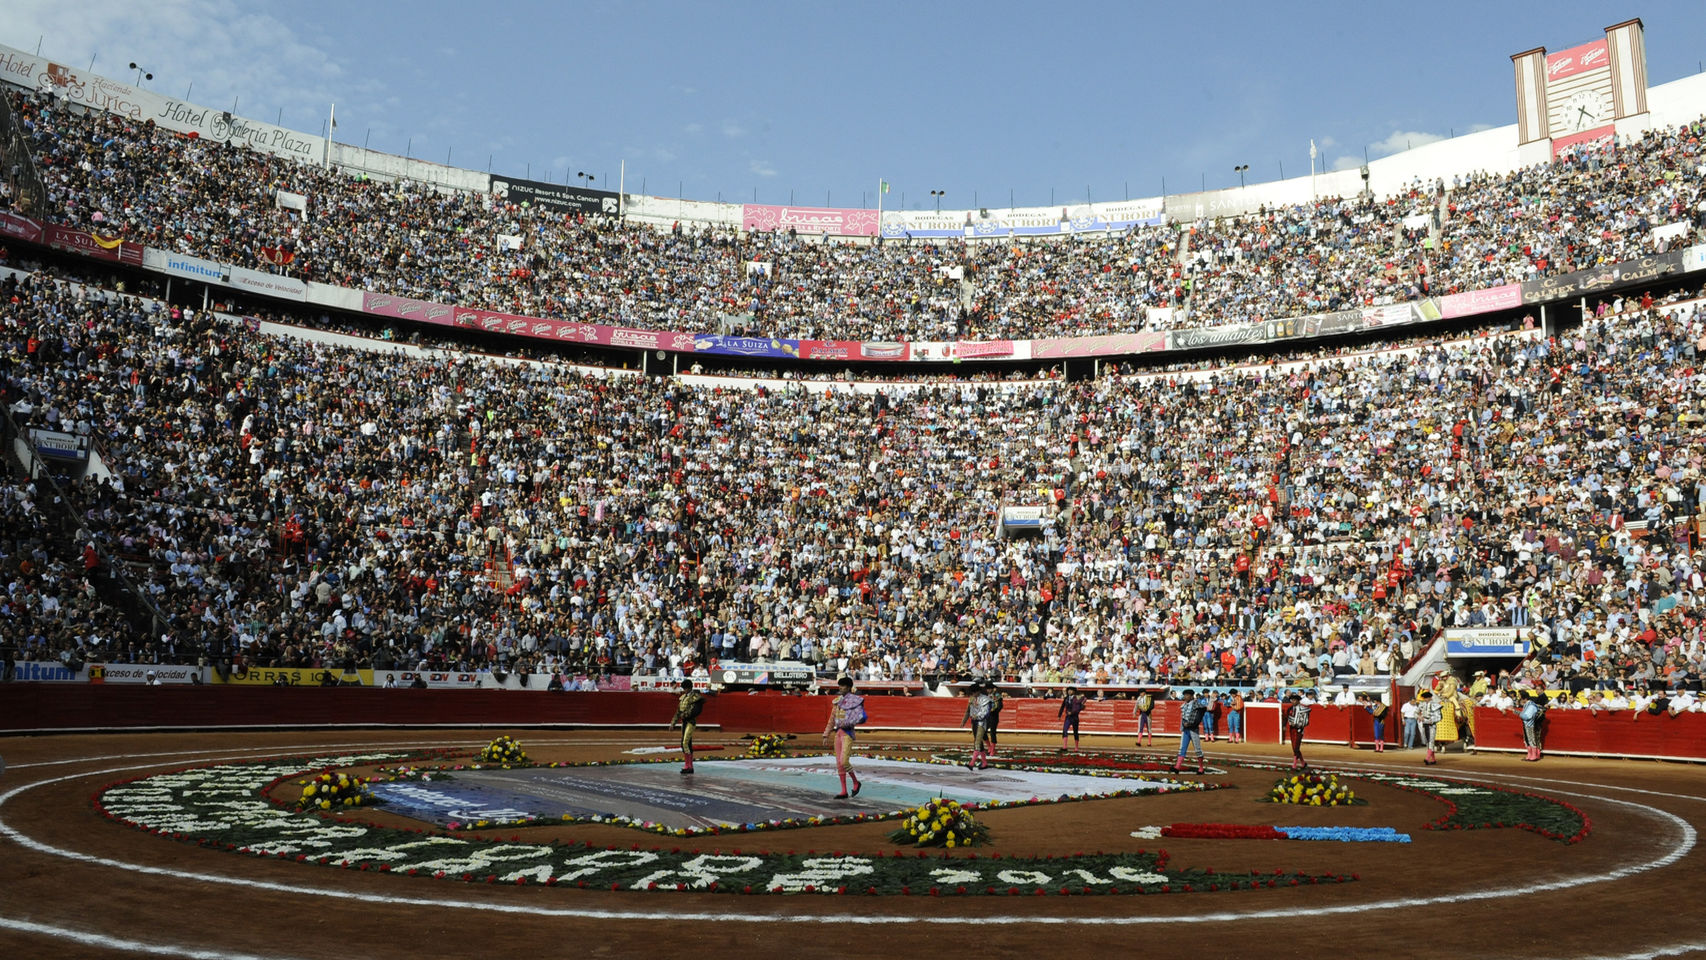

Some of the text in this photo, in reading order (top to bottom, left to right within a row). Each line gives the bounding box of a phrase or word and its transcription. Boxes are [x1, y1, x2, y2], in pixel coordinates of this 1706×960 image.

[0, 53, 36, 78] Hotel
[158, 101, 209, 128] Hotel
[271, 129, 312, 155] Plaza
[534, 188, 555, 197] Resort
[168, 258, 223, 279] infinitum
[1620, 262, 1677, 282] CALMX
[1524, 283, 1576, 300] CALMEX
[742, 340, 769, 349] SUIZA
[1188, 330, 1208, 346] los
[1210, 327, 1264, 343] amantes
[105, 670, 130, 679] xceso
[132, 670, 143, 679] de
